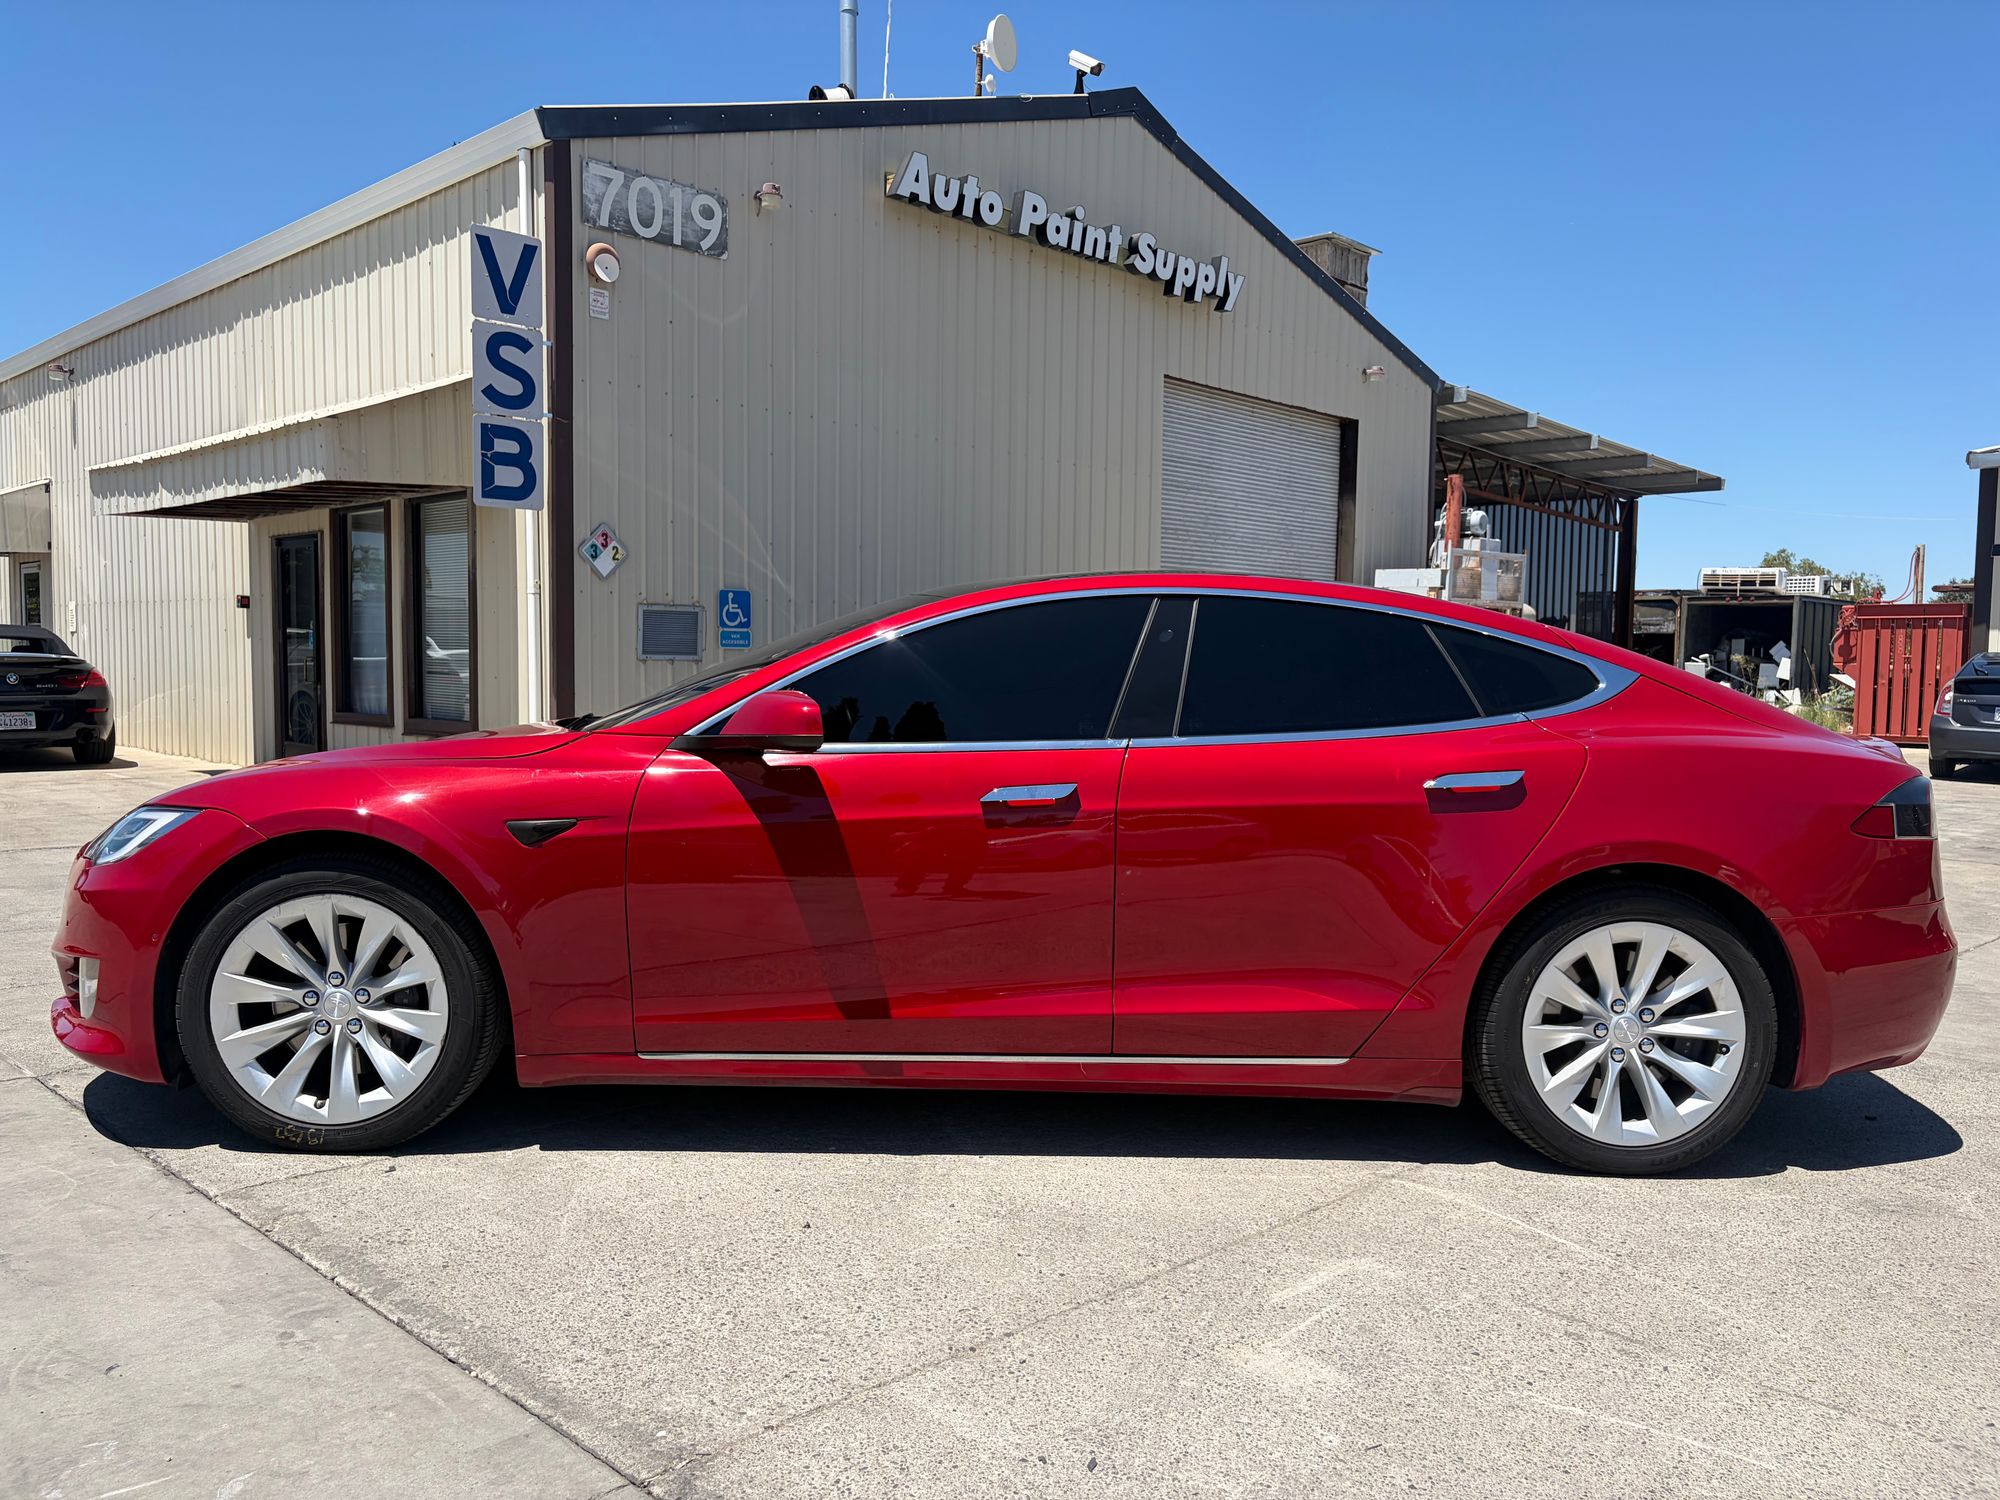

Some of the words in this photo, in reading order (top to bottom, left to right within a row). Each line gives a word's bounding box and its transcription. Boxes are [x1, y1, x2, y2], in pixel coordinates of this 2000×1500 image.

[586, 163, 724, 252] 7019
[893, 151, 1004, 227] Auto
[1014, 189, 1123, 264] Paint
[1130, 232, 1246, 312] Supply
[601, 532, 609, 548] 3
[590, 544, 598, 559] 3
[612, 545, 620, 561] 2
